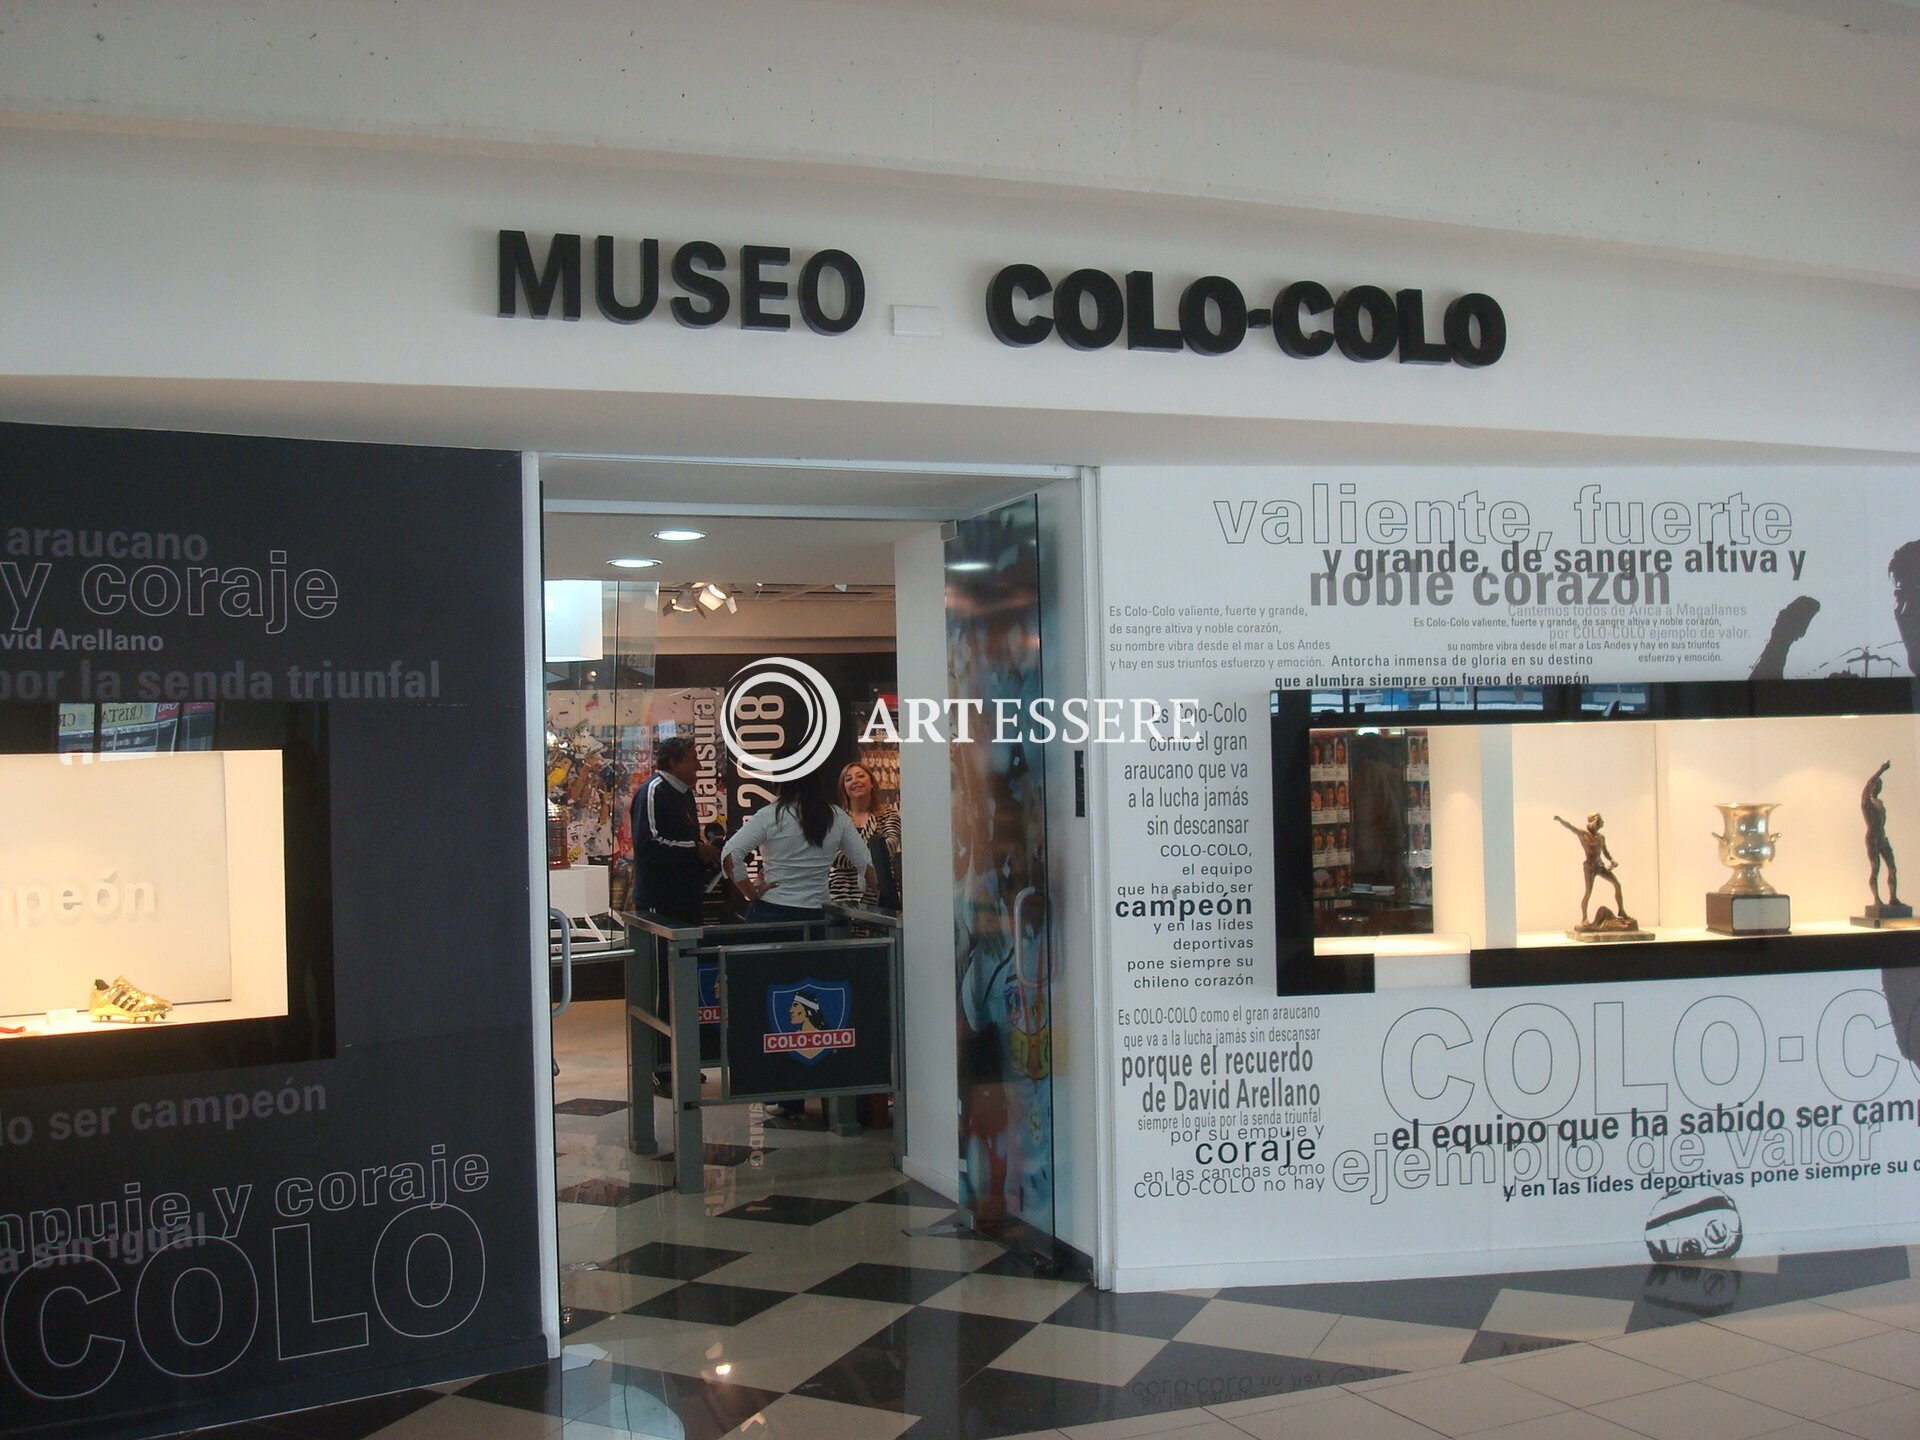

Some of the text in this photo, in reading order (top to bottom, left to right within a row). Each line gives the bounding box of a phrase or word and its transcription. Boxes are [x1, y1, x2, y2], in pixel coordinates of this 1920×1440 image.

[497, 230, 1506, 369] MUSEO COLO-COLO
[1213, 483, 1792, 551] valiente, fuerte
[7, 527, 208, 561] araucano
[1323, 540, 1806, 581] y grande, de sangre altiva y
[0, 550, 339, 634] y coraje
[1311, 558, 1453, 606] noble
[1109, 604, 1308, 618] Es Colo-Colo valiente, fuerte y grande,
[50, 629, 164, 651] Arellano
[1109, 622, 1282, 637] de sangre altiva noble corazón,
[1110, 639, 1331, 652] su nombre vibra desde el mar Los Andes
[1119, 657, 1266, 670] hay en sus triunfos esfuerzo
[1331, 653, 1593, 668] Antorcha inmensa de gloria en su destino
[80, 659, 121, 699] la
[138, 660, 273, 700] senda
[287, 660, 440, 699] triunfal
[1275, 672, 1526, 690] que alumbra siempre con de
[1196, 730, 1247, 755] el gran
[1124, 762, 1248, 783] araucano que va
[1128, 785, 1249, 811] a la lucha jamás
[1147, 814, 1249, 835] sin descansar
[1160, 843, 1252, 857] COLO-COLO,
[1182, 862, 1253, 877] el equipo
[1117, 881, 1253, 898] que ha sabido ser
[1115, 892, 1252, 921] campeón
[1153, 918, 1254, 935] y en las lides
[1173, 937, 1254, 952] deportivas
[1127, 956, 1253, 972] pone siempre su
[1133, 973, 1254, 989] chileno corazón
[1118, 1006, 1320, 1026] Es COLO-COLO como el gran araucano
[1123, 1026, 1320, 1051] que va a la lucha jamás sin descansar
[1121, 1042, 1313, 1086] porque el recuerdo
[1381, 988, 1920, 1126] COLO-C
[1142, 1077, 1320, 1112] de David Arellano
[49, 1076, 327, 1141] ser campeón
[1171, 1125, 1325, 1146] por su empuje y
[1392, 1099, 1920, 1153] el equipo que ha sabido ser cam
[1195, 1131, 1316, 1168] coraje
[1332, 1110, 1881, 1204] ejemplo de valor
[1143, 1163, 1325, 1183] en las canchas como
[1522, 1159, 1908, 1198] en las lides deportivas pone siempre su
[212, 1184, 253, 1240] y
[275, 1144, 490, 1210] coraje
[1134, 1175, 1325, 1198] COLO-COLO no hay
[33, 1231, 94, 1269] sin
[107, 1212, 206, 1265] igual
[2, 1203, 486, 1399] COLO
